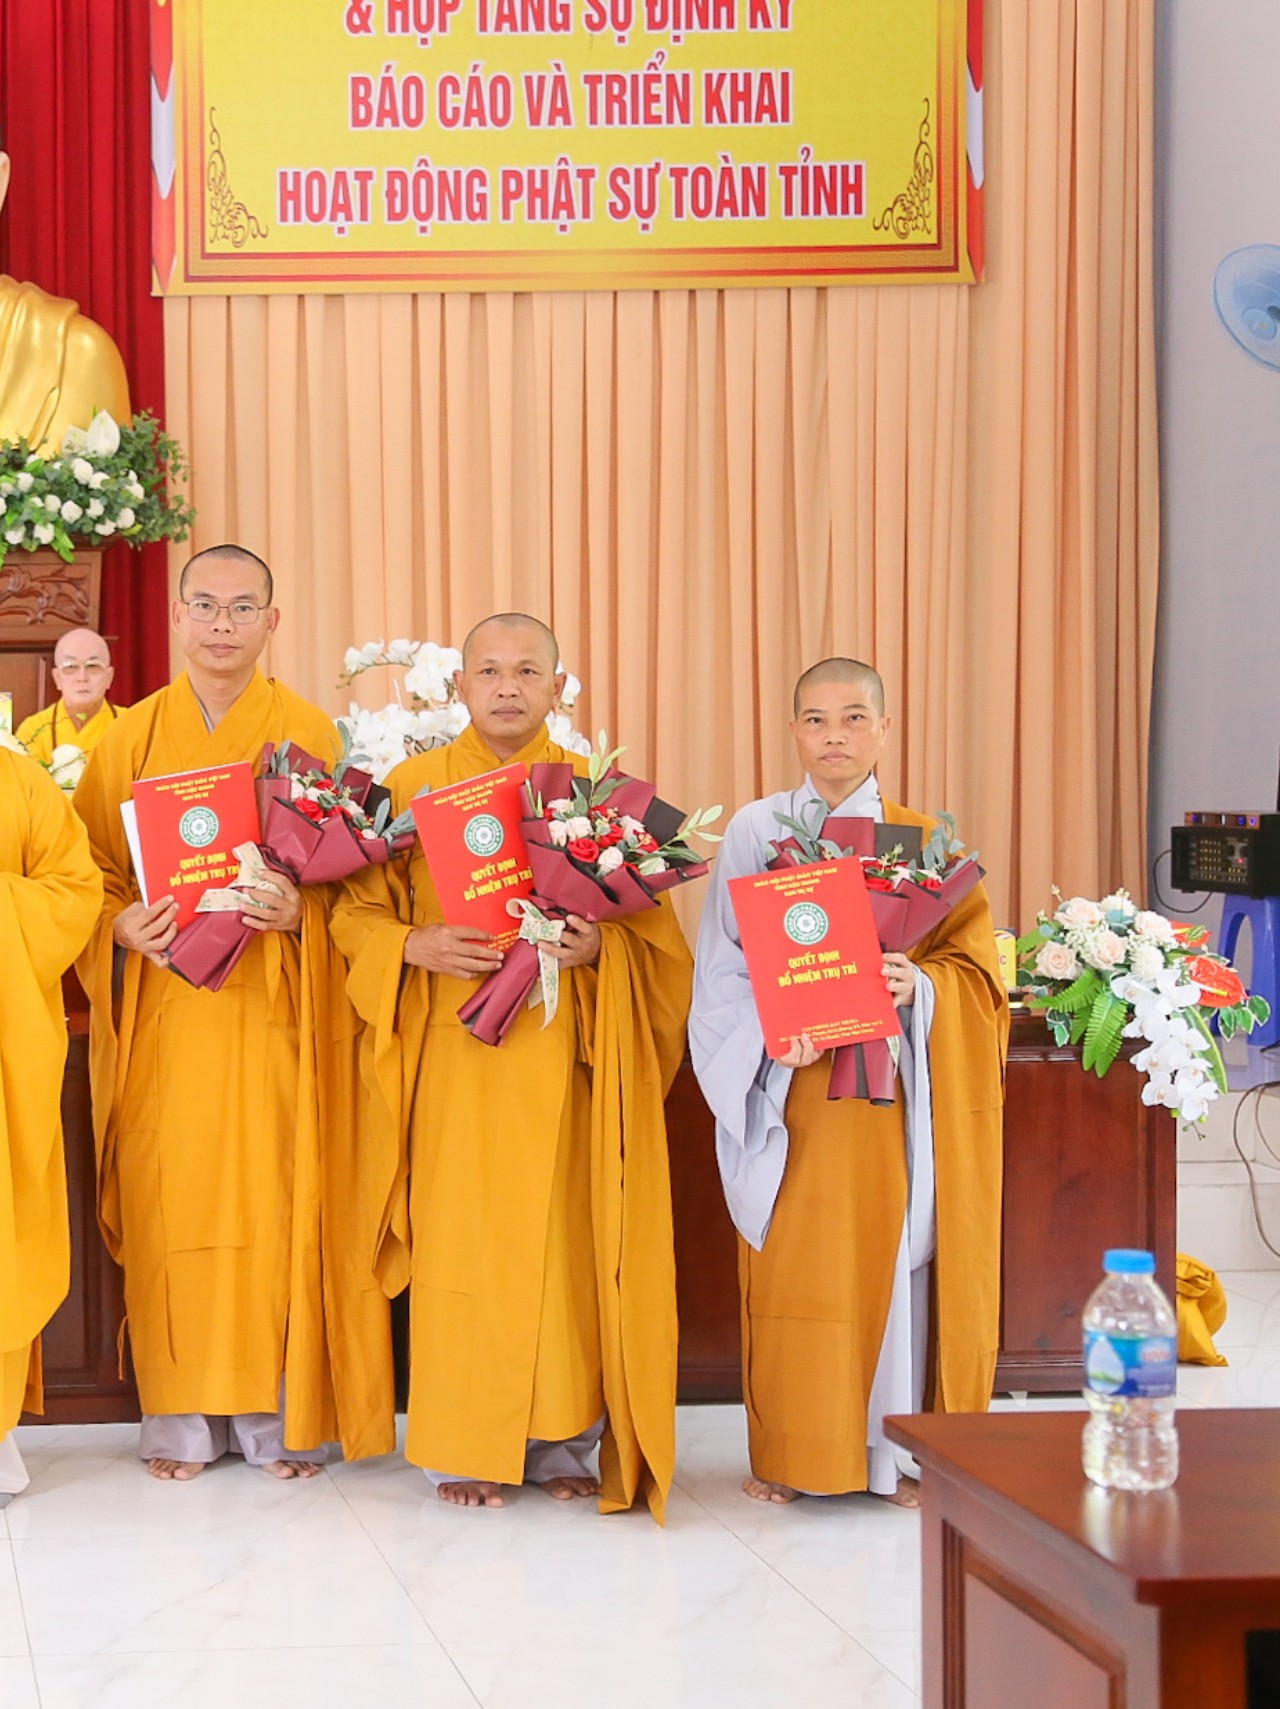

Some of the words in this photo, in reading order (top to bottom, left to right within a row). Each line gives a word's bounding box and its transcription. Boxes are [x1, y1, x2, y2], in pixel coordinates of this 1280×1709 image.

[345, 0, 373, 35] &
[350, 64, 425, 129] BÁO
[438, 63, 512, 128] CÁO
[523, 63, 573, 127] VÀ
[582, 50, 691, 126] TRIỂN
[704, 71, 790, 125] KHAI
[278, 170, 375, 235] HOẠT
[385, 157, 488, 234] ĐỘNG
[501, 156, 597, 233] PHẬT
[608, 161, 662, 232] SỰ
[669, 154, 767, 219] TOÀN
[778, 146, 864, 217] TỈNH
